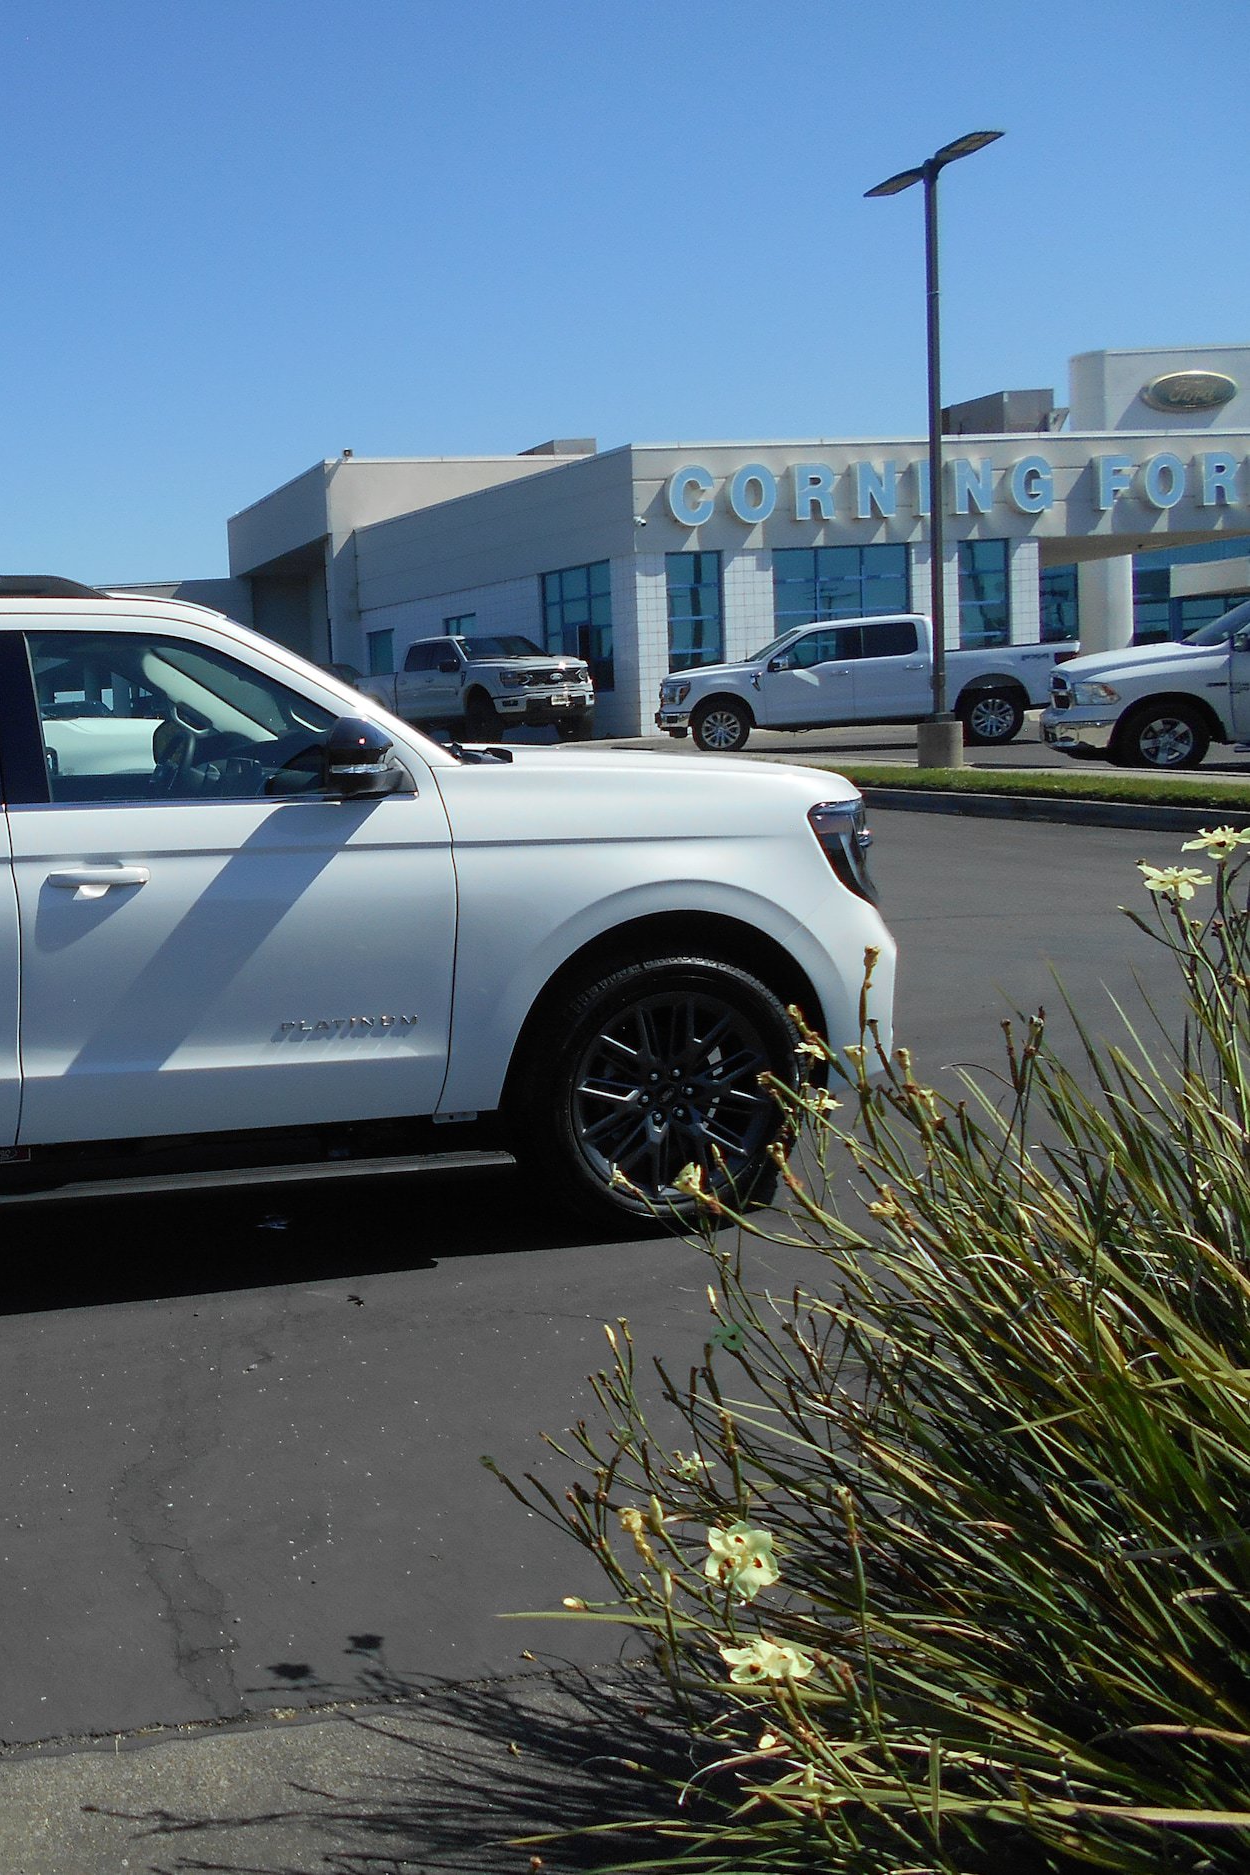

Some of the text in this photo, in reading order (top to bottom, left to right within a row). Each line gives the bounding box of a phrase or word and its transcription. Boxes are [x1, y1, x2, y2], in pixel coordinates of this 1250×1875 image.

[667, 452, 1250, 527] CORNING FOR
[280, 1013, 418, 1033] PLATINUM
